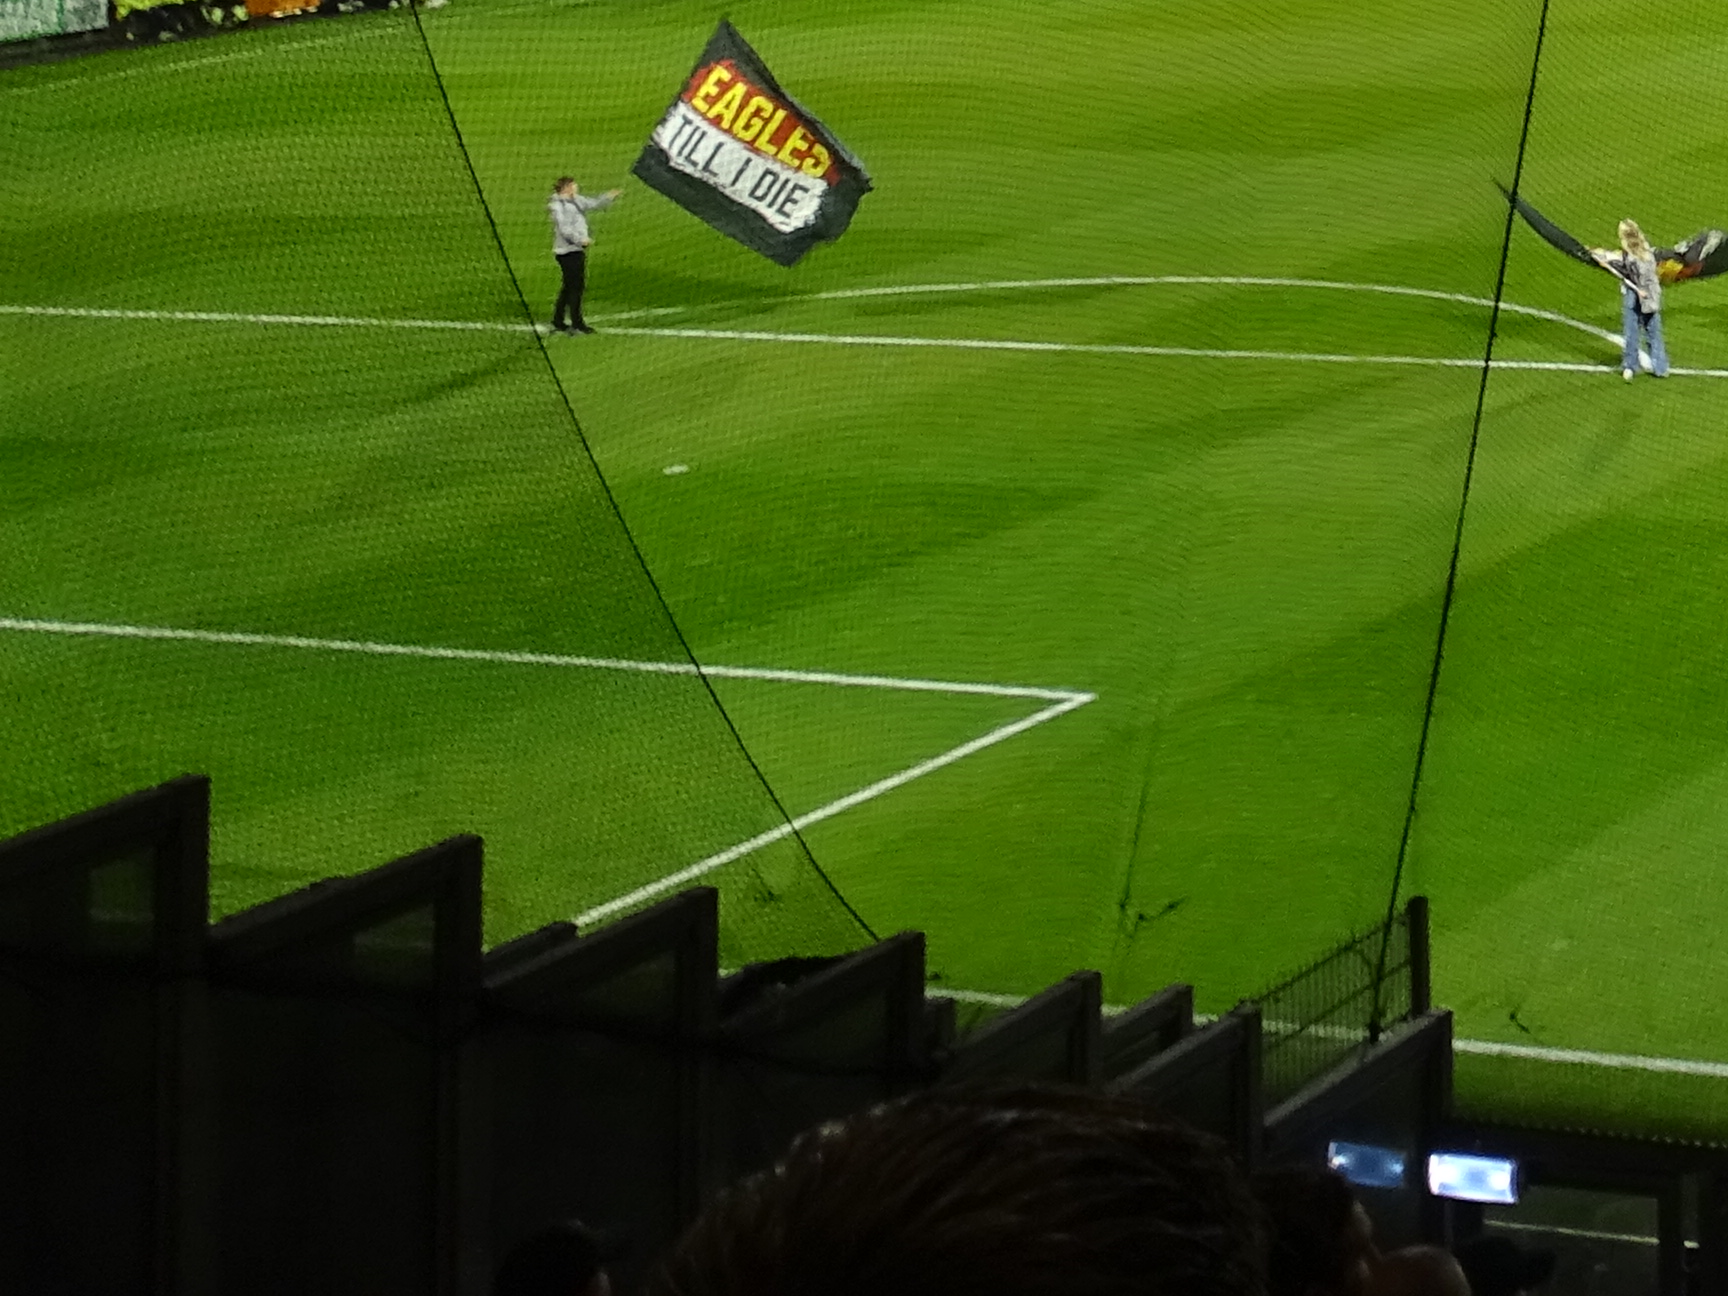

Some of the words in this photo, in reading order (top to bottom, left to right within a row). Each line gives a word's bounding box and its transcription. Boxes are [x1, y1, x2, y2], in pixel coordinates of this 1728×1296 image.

[668, 114, 728, 178] TILL
[730, 156, 753, 188] I
[748, 166, 810, 220] DIE
